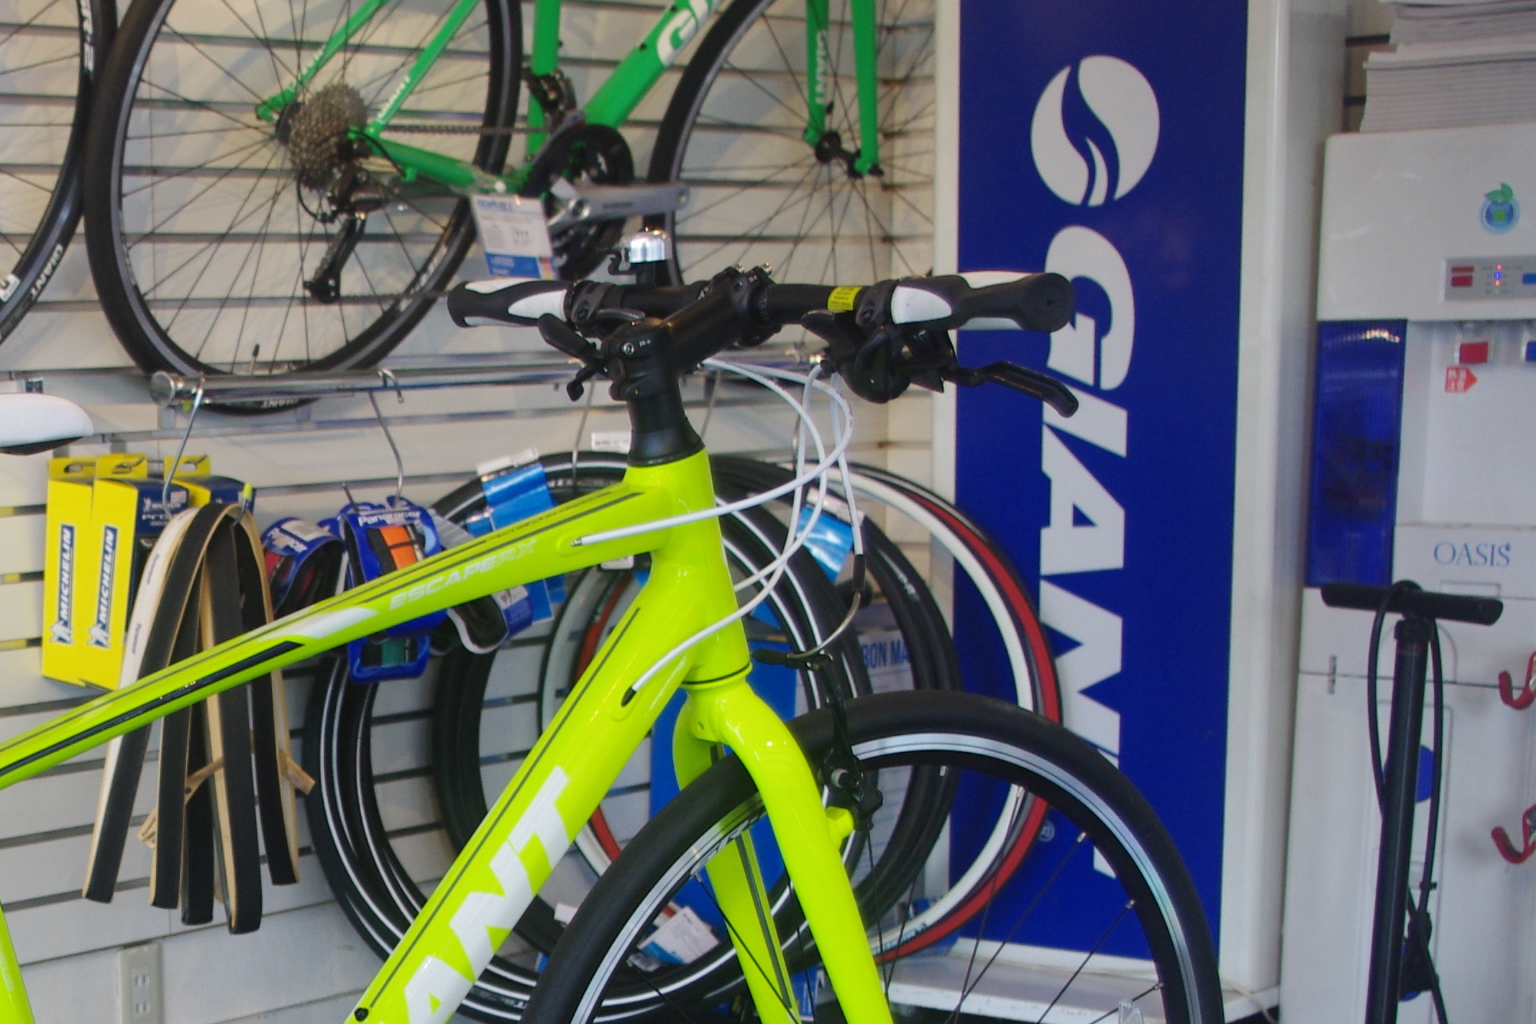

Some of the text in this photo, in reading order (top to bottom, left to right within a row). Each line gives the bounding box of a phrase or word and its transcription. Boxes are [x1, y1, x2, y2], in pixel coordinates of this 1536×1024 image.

[29, 243, 65, 300] GIANT
[59, 525, 74, 625] MICHELIN
[97, 527, 116, 629] MICHELIN
[389, 557, 501, 611] ESCAPE
[1433, 541, 1512, 567] OASIS
[690, 810, 767, 876] SR-
